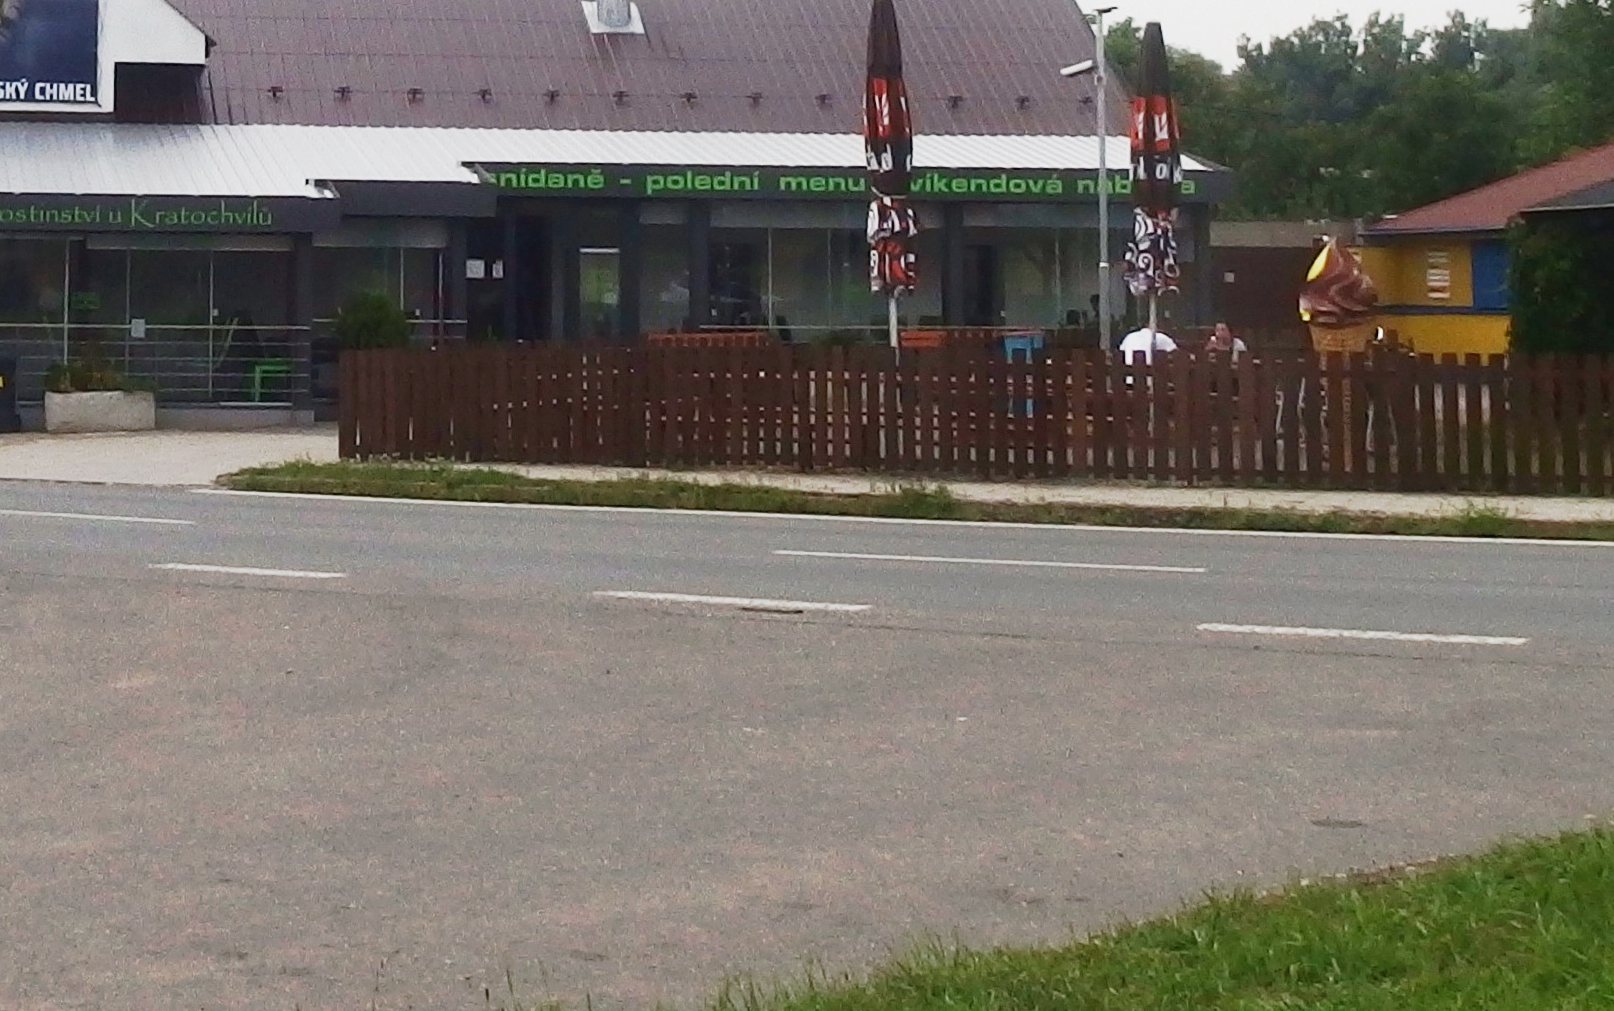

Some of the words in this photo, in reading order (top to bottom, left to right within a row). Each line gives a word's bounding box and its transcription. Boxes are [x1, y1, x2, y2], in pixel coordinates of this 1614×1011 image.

[35, 82, 96, 102] CHMEL
[646, 170, 760, 195] polední
[779, 176, 866, 191] menu
[108, 209, 122, 223] u
